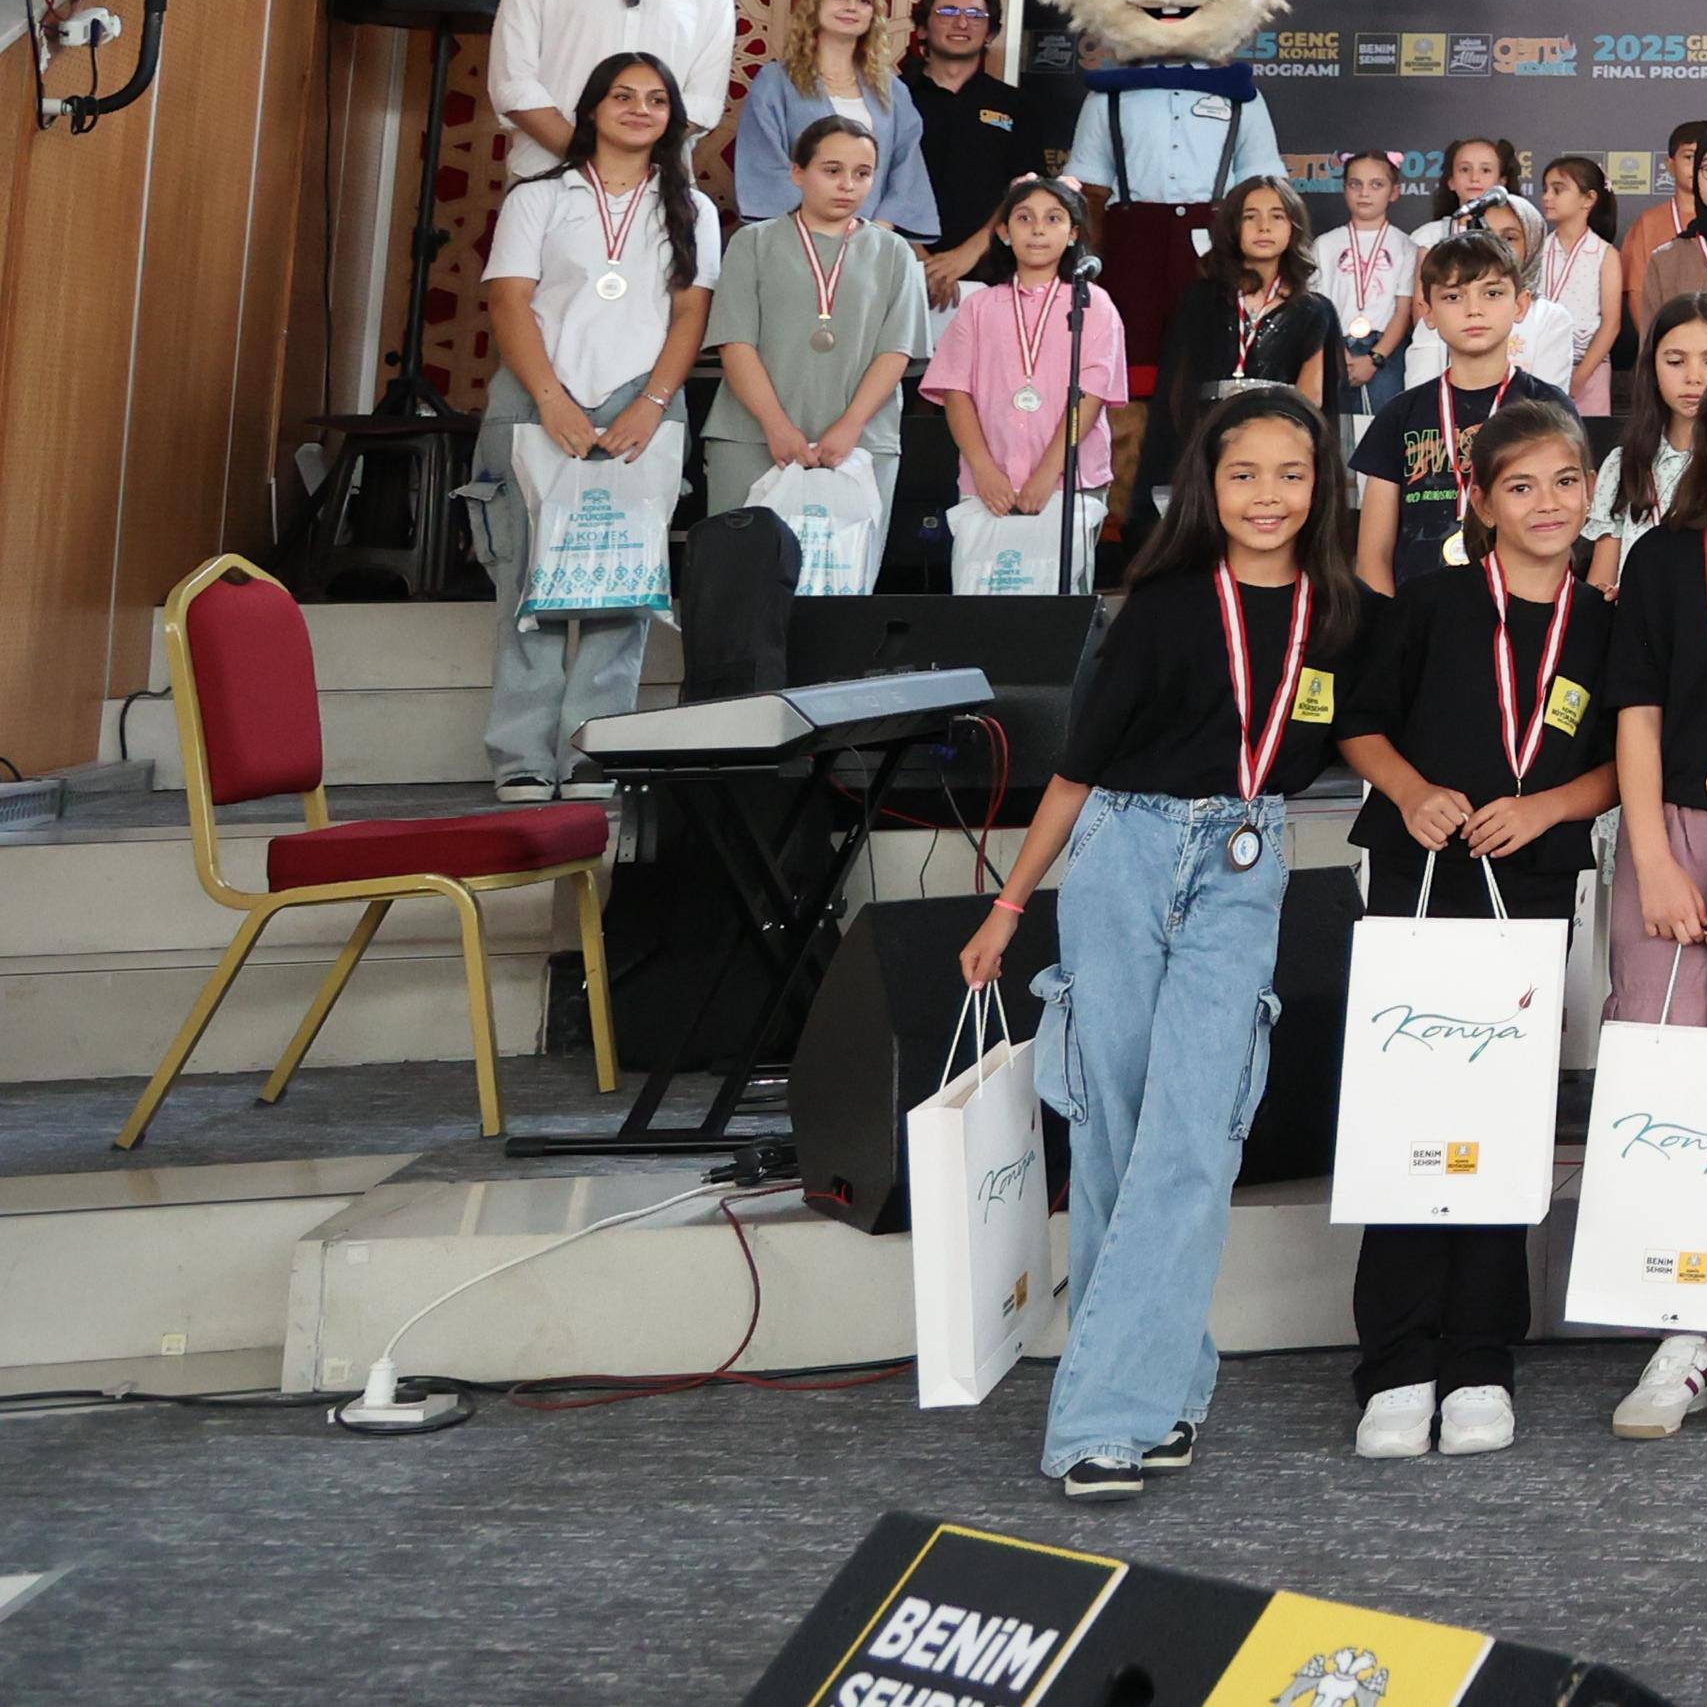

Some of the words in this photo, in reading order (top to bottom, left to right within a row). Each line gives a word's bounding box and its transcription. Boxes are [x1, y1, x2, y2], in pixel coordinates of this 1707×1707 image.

[1280, 45, 1338, 59] KOMEK
[1594, 33, 1686, 61] 2025
[1253, 64, 1339, 76] ROGRAMI
[1371, 1006, 1527, 1062] Konya
[868, 1596, 1060, 1691] BENİM
